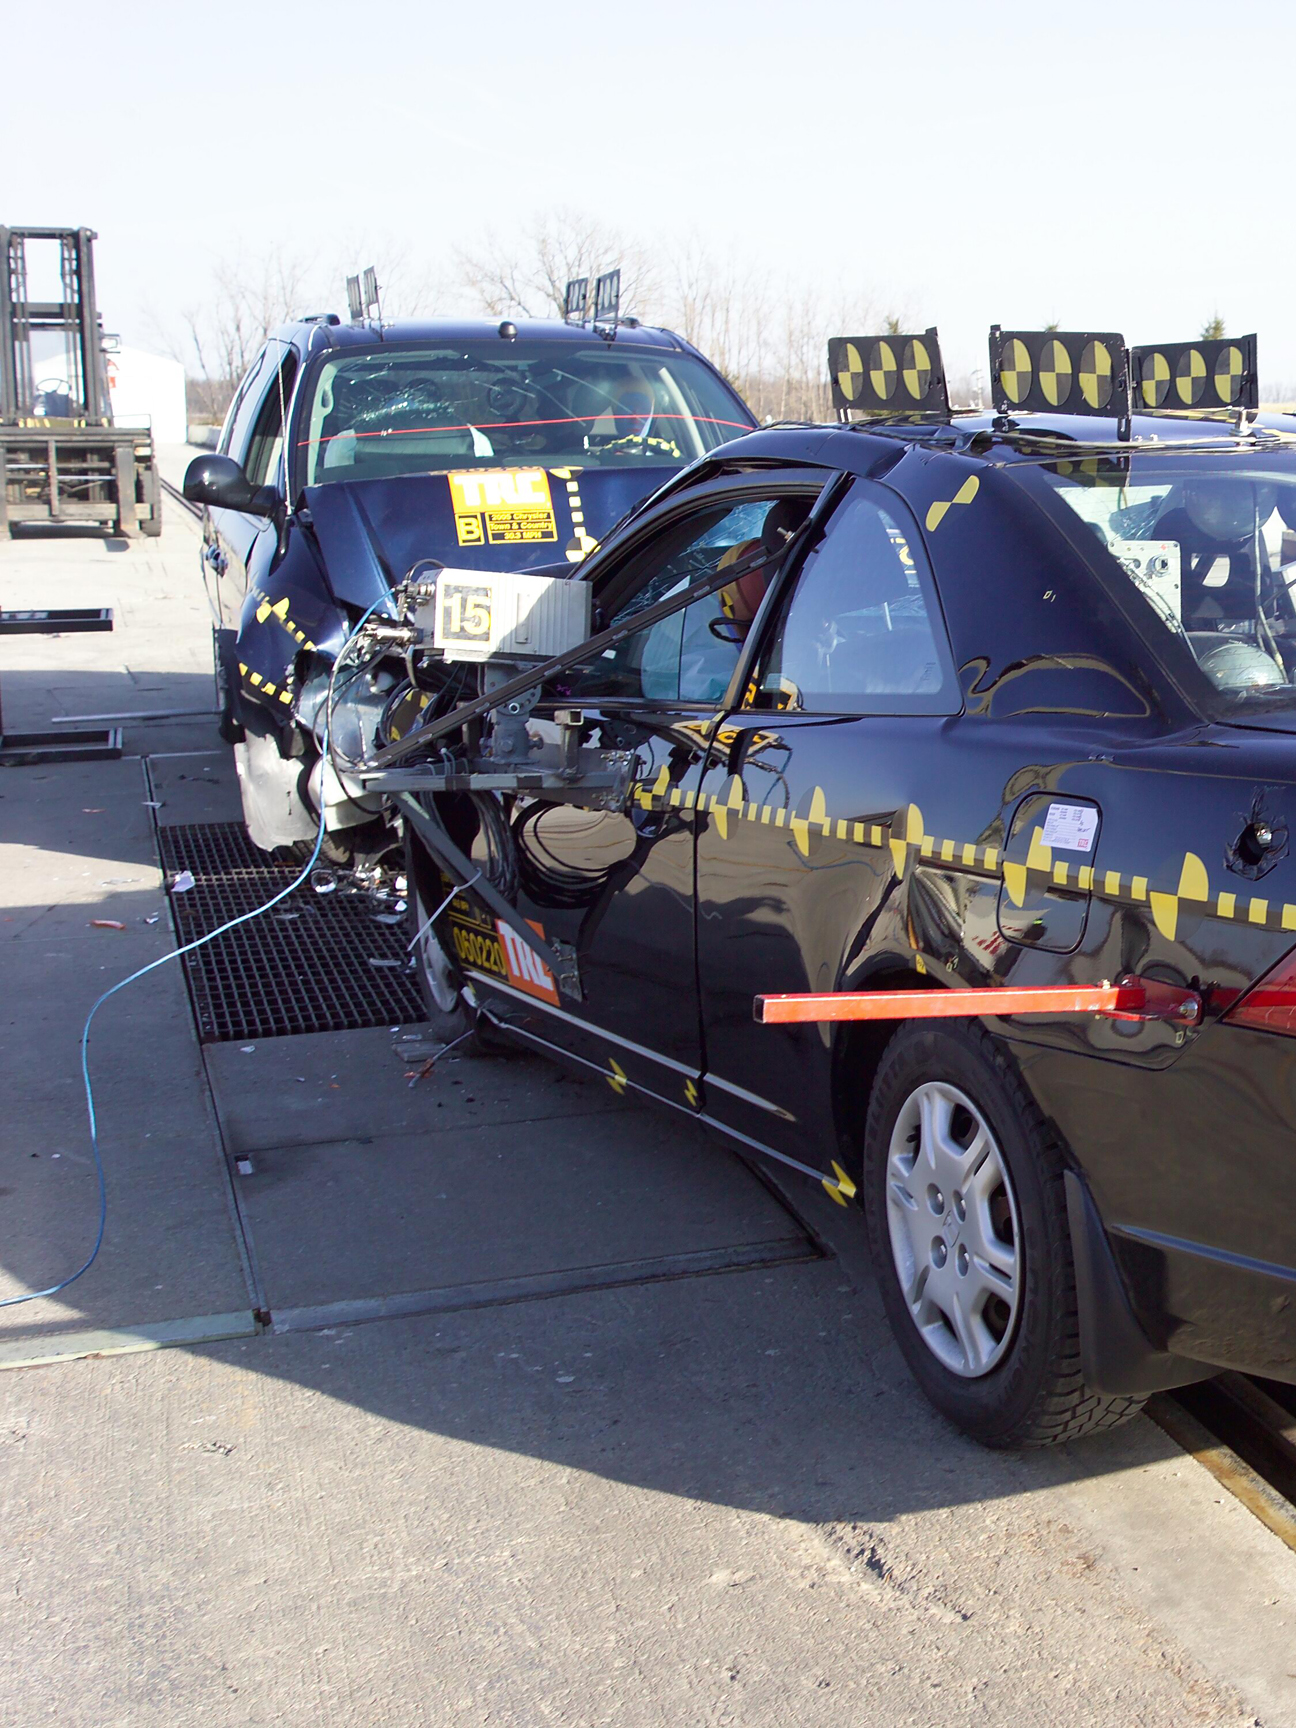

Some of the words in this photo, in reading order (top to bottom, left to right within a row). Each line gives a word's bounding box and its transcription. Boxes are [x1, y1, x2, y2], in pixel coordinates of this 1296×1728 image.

[453, 472, 546, 507] TRC
[513, 512, 548, 521] Chrysler
[520, 522, 553, 530] Country
[458, 517, 480, 540] B
[523, 531, 542, 539] MPH
[443, 592, 491, 636] 15
[453, 926, 507, 976] 060220
